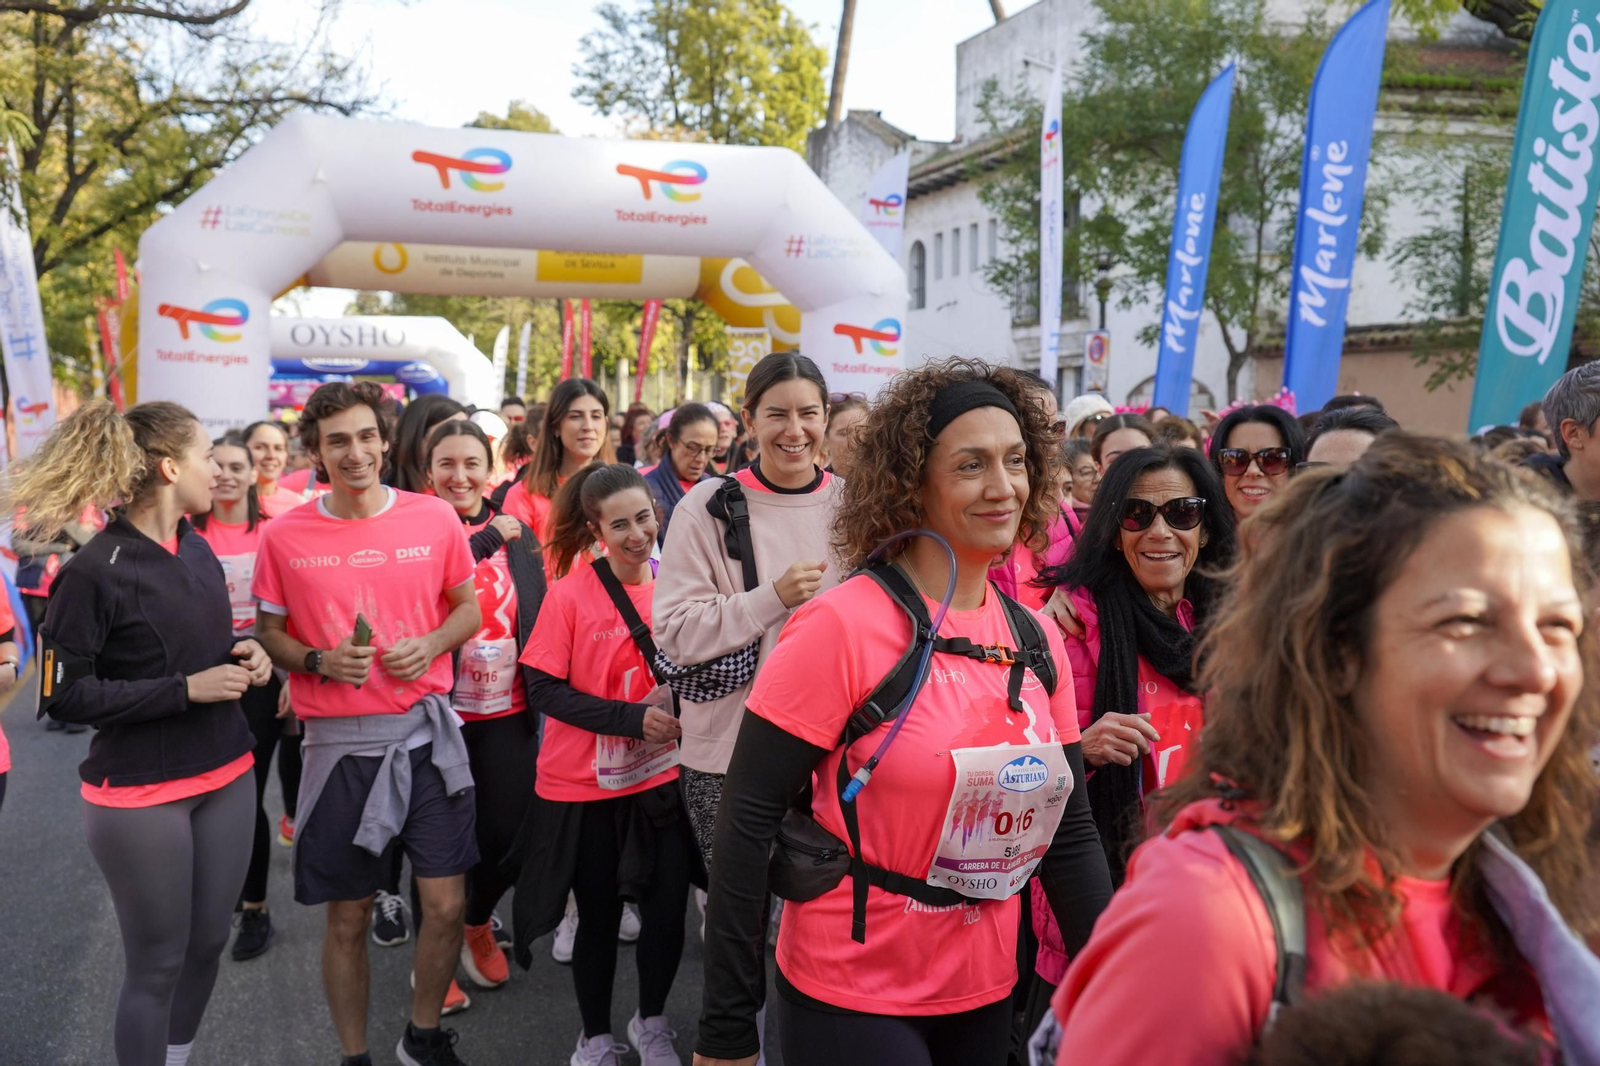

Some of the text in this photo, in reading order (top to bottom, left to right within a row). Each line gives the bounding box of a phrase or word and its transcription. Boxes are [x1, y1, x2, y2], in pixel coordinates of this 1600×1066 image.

[411, 199, 513, 217] TotalEnergies
[614, 209, 708, 226] TotalEnergies
[1297, 140, 1353, 327] Marlene
[423, 253, 521, 269] Instituto Municipal
[439, 268, 505, 281] de Deportes
[1164, 192, 1206, 353] Marlene
[290, 323, 406, 347] OYSHO
[156, 350, 248, 366] TotalEnergies
[395, 546, 431, 558] DKV
[289, 555, 340, 570] OYSHO
[472, 671, 498, 683] 016
[608, 773, 637, 786] OYSHO
[966, 777, 994, 787] SUMA
[1001, 770, 1046, 785] ASTURIANA
[994, 808, 1035, 836] 016
[958, 862, 989, 871] CARRERA
[991, 861, 1000, 870] DE
[1002, 862, 1011, 870] LA
[947, 875, 998, 890] OYSHO
